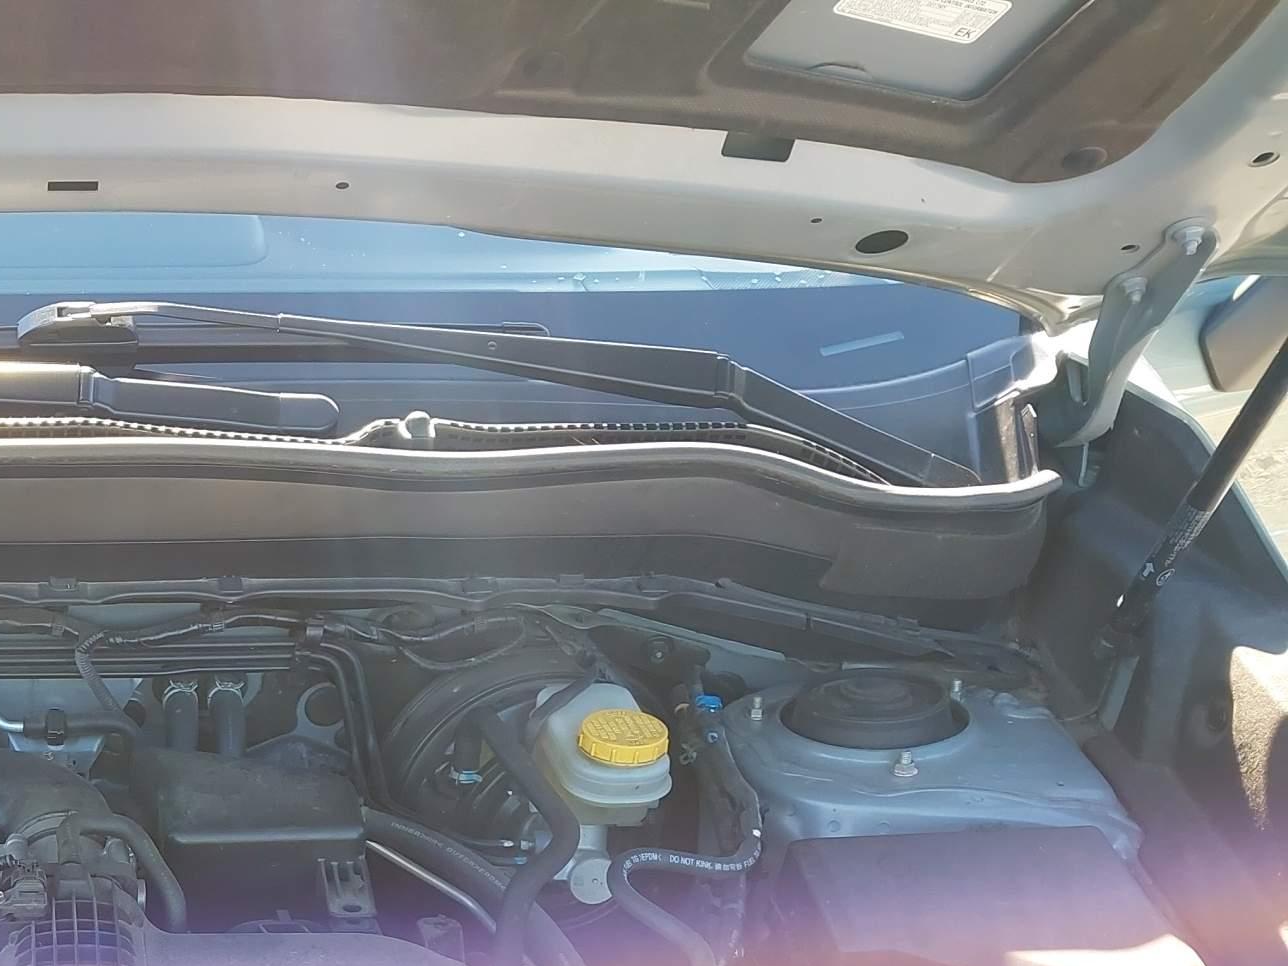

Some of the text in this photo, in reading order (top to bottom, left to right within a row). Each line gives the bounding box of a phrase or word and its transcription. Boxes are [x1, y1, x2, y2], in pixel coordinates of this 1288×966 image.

[954, 27, 977, 39] EK
[669, 854, 680, 863] DO
[680, 856, 695, 866] NOT
